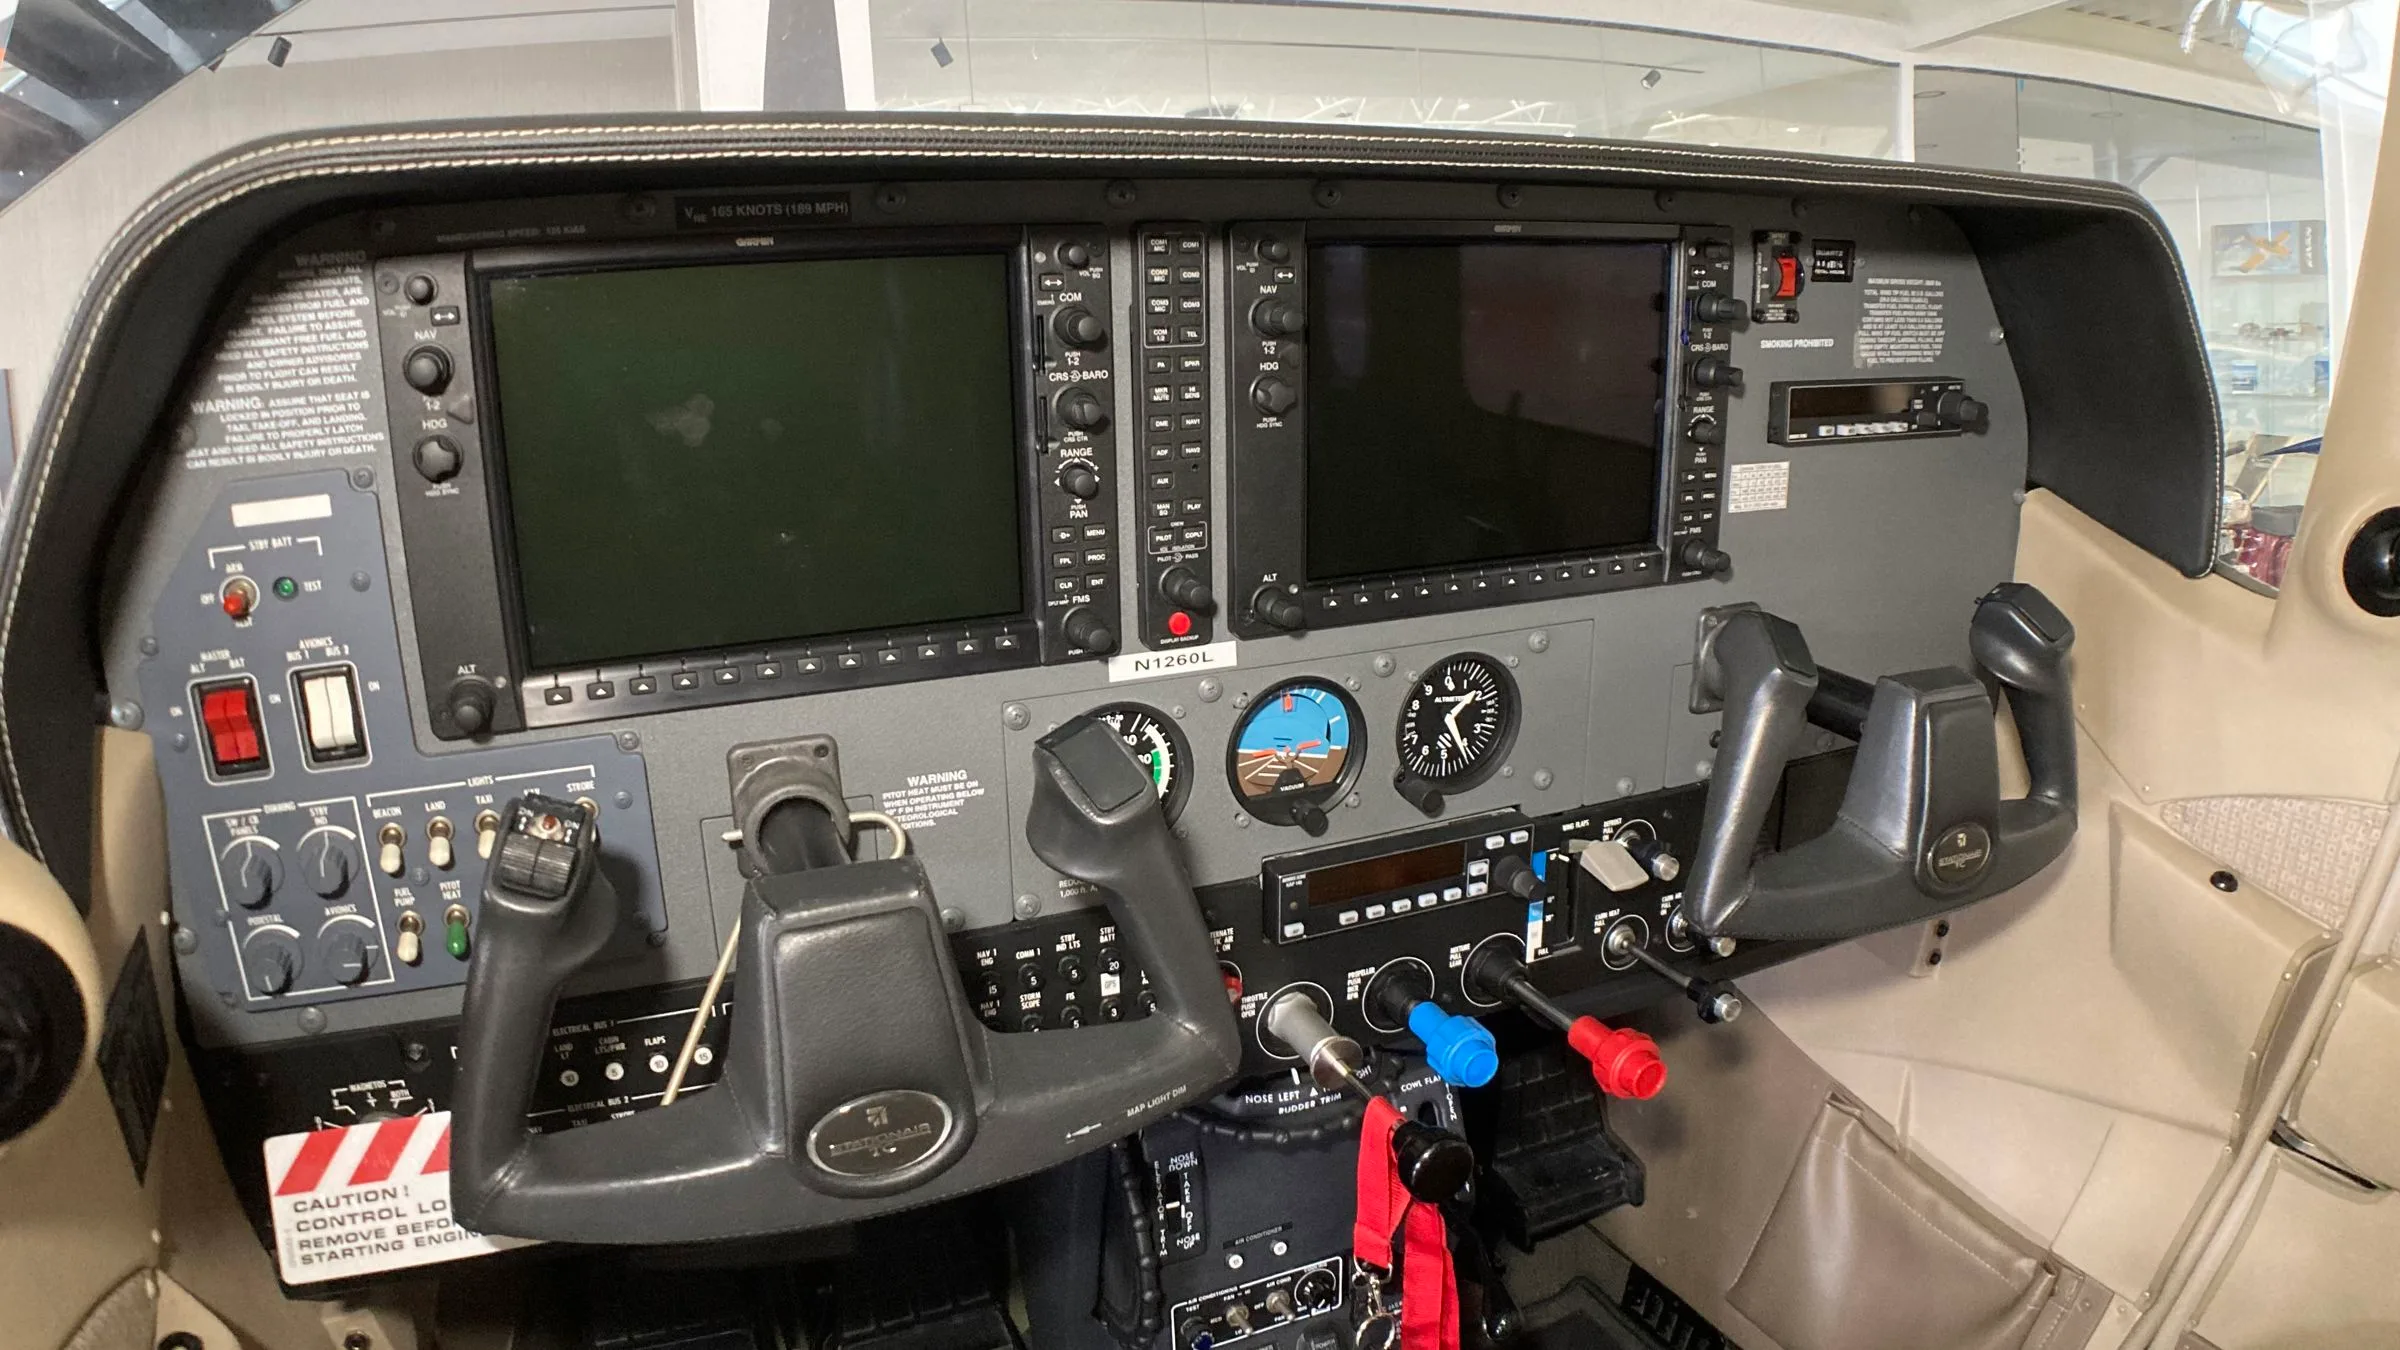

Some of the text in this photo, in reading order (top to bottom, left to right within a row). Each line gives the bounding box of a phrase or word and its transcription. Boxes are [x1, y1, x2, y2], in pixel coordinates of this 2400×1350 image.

[711, 205, 732, 218] 165
[736, 204, 783, 217] KNOTS
[785, 203, 812, 216] (189
[814, 202, 849, 215] MPH)
[1702, 280, 1717, 288] COM
[1259, 285, 1278, 294] NAV
[1059, 292, 1082, 302] COM
[414, 329, 437, 340] NAV
[1760, 338, 1834, 349] SMOKING PROHIBITED
[1067, 357, 1080, 366] 1-2
[1259, 363, 1279, 372] HDG
[1049, 370, 1109, 382] CRS BARO
[426, 401, 441, 411] 1-2
[1693, 405, 1715, 414] RANGE
[422, 419, 448, 430] HDG
[1060, 447, 1093, 457] RANGE
[1069, 509, 1089, 519] PAN
[1086, 528, 1106, 537] MENU
[1155, 534, 1172, 542] PILOT
[1087, 553, 1106, 562] PROC
[1091, 578, 1104, 587] ENT
[1263, 573, 1278, 582] ALT
[303, 580, 322, 592] TEST
[1059, 581, 1073, 590] CLR
[1072, 594, 1091, 604] FMS
[299, 636, 333, 649] AVIONICS
[1134, 651, 1214, 672] N1260L
[457, 664, 477, 675] ALT
[368, 681, 380, 692] ON
[1425, 685, 1433, 695] 9
[268, 693, 282, 704] ON
[1475, 690, 1483, 700] 2
[1411, 700, 1420, 710] 8
[1473, 723, 1481, 734] 3
[1411, 734, 1418, 745] 7
[1422, 745, 1430, 755] 6
[1440, 750, 1448, 759] 5
[467, 775, 495, 788] LIGHTS
[907, 769, 968, 787] WARNING
[566, 781, 595, 793] STROBE
[882, 780, 979, 800] PITOT HEAT MUST BE ON
[475, 794, 494, 805] TAXI
[883, 788, 985, 808] WHEN OPERATING BELOW
[425, 801, 446, 812] LAND
[915, 799, 965, 812] INSTRUMENT
[309, 806, 328, 817] STBY
[372, 807, 402, 819] BEACON
[517, 807, 534, 817] ON
[564, 821, 580, 831] ON
[439, 880, 461, 892] PITOT
[394, 888, 411, 898] FUEL
[442, 889, 462, 901] HEAT
[1060, 888, 1079, 898] 1,000
[394, 896, 415, 908] PUMP
[324, 904, 357, 916] AVIONICS
[1100, 926, 1115, 935] STBY
[1060, 933, 1076, 943] STBY
[1100, 934, 1115, 943] BATT
[1069, 940, 1081, 950] LTS
[980, 957, 994, 967] ENG
[1109, 961, 1120, 970] 20
[1071, 970, 1078, 979] 5
[1347, 966, 1376, 979] PROPELLER
[1030, 976, 1037, 986] 5
[989, 985, 998, 995] 15
[1019, 992, 1041, 1002] STORM
[1241, 992, 1268, 1004] THROTTLE
[1022, 1000, 1040, 1010] SCOPE
[1150, 1003, 1156, 1012] 5
[1241, 1002, 1256, 1011] PUSH
[1111, 1008, 1117, 1017] 3
[1241, 1009, 1256, 1019] OPEN
[552, 1023, 591, 1037] ELECTRICAL
[593, 1021, 608, 1032] BUS
[1073, 1020, 1079, 1029] 5
[644, 1035, 666, 1047] FLAPS
[554, 1043, 574, 1053] LAND
[699, 1052, 708, 1061] 15
[1401, 1075, 1442, 1092] COWL FLA
[1127, 1084, 1187, 1118] MAP LIGHT DIM
[1245, 1090, 1300, 1104] NOSE LEFT
[1278, 1092, 1342, 1115] RUDDER TRIM
[1170, 1151, 1195, 1164] NOSE
[1168, 1158, 1198, 1172] DOWN
[1183, 1172, 1191, 1203] TAKE
[1154, 1161, 1168, 1257] ELEVATOR TRIM
[296, 1199, 447, 1233] CONTROL LO
[298, 1228, 386, 1251] REMOVE
[397, 1217, 456, 1236] BEFO
[1234, 1226, 1283, 1246] AIR CONDITIONER
[1176, 1233, 1200, 1246] NOSE
[1184, 1241, 1195, 1250] UP
[301, 1239, 404, 1266] STARTING
[1198, 1286, 1238, 1301] CONDITIONING
[1223, 1293, 1235, 1301] FAN
[1185, 1304, 1200, 1313] TEST
[1254, 1303, 1265, 1311] OFF
[1274, 1315, 1285, 1323] FAN
